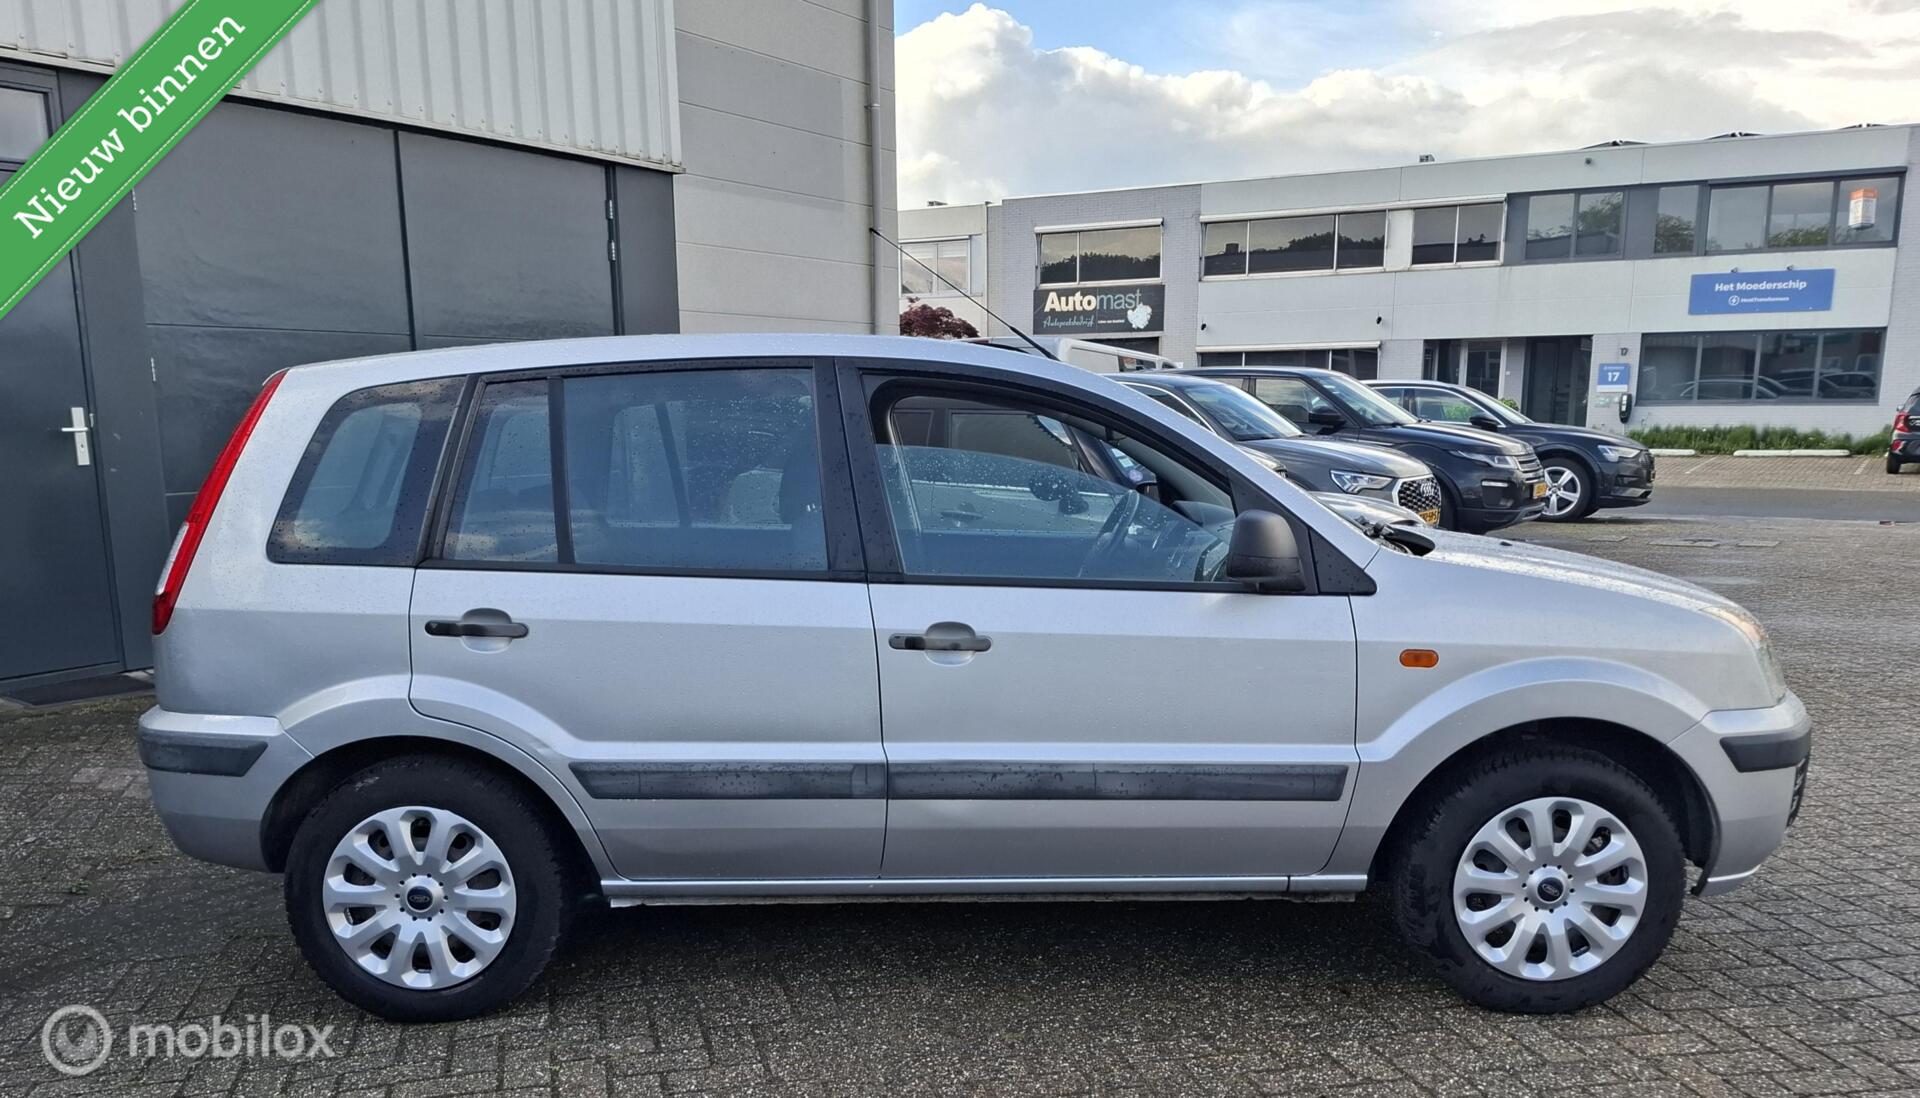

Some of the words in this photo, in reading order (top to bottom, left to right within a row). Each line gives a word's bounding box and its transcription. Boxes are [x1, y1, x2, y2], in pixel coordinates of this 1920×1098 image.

[1714, 282, 1735, 292] Het
[1736, 279, 1807, 291] Moederschip
[1044, 289, 1142, 312] Automast
[1607, 371, 1620, 382] 17
